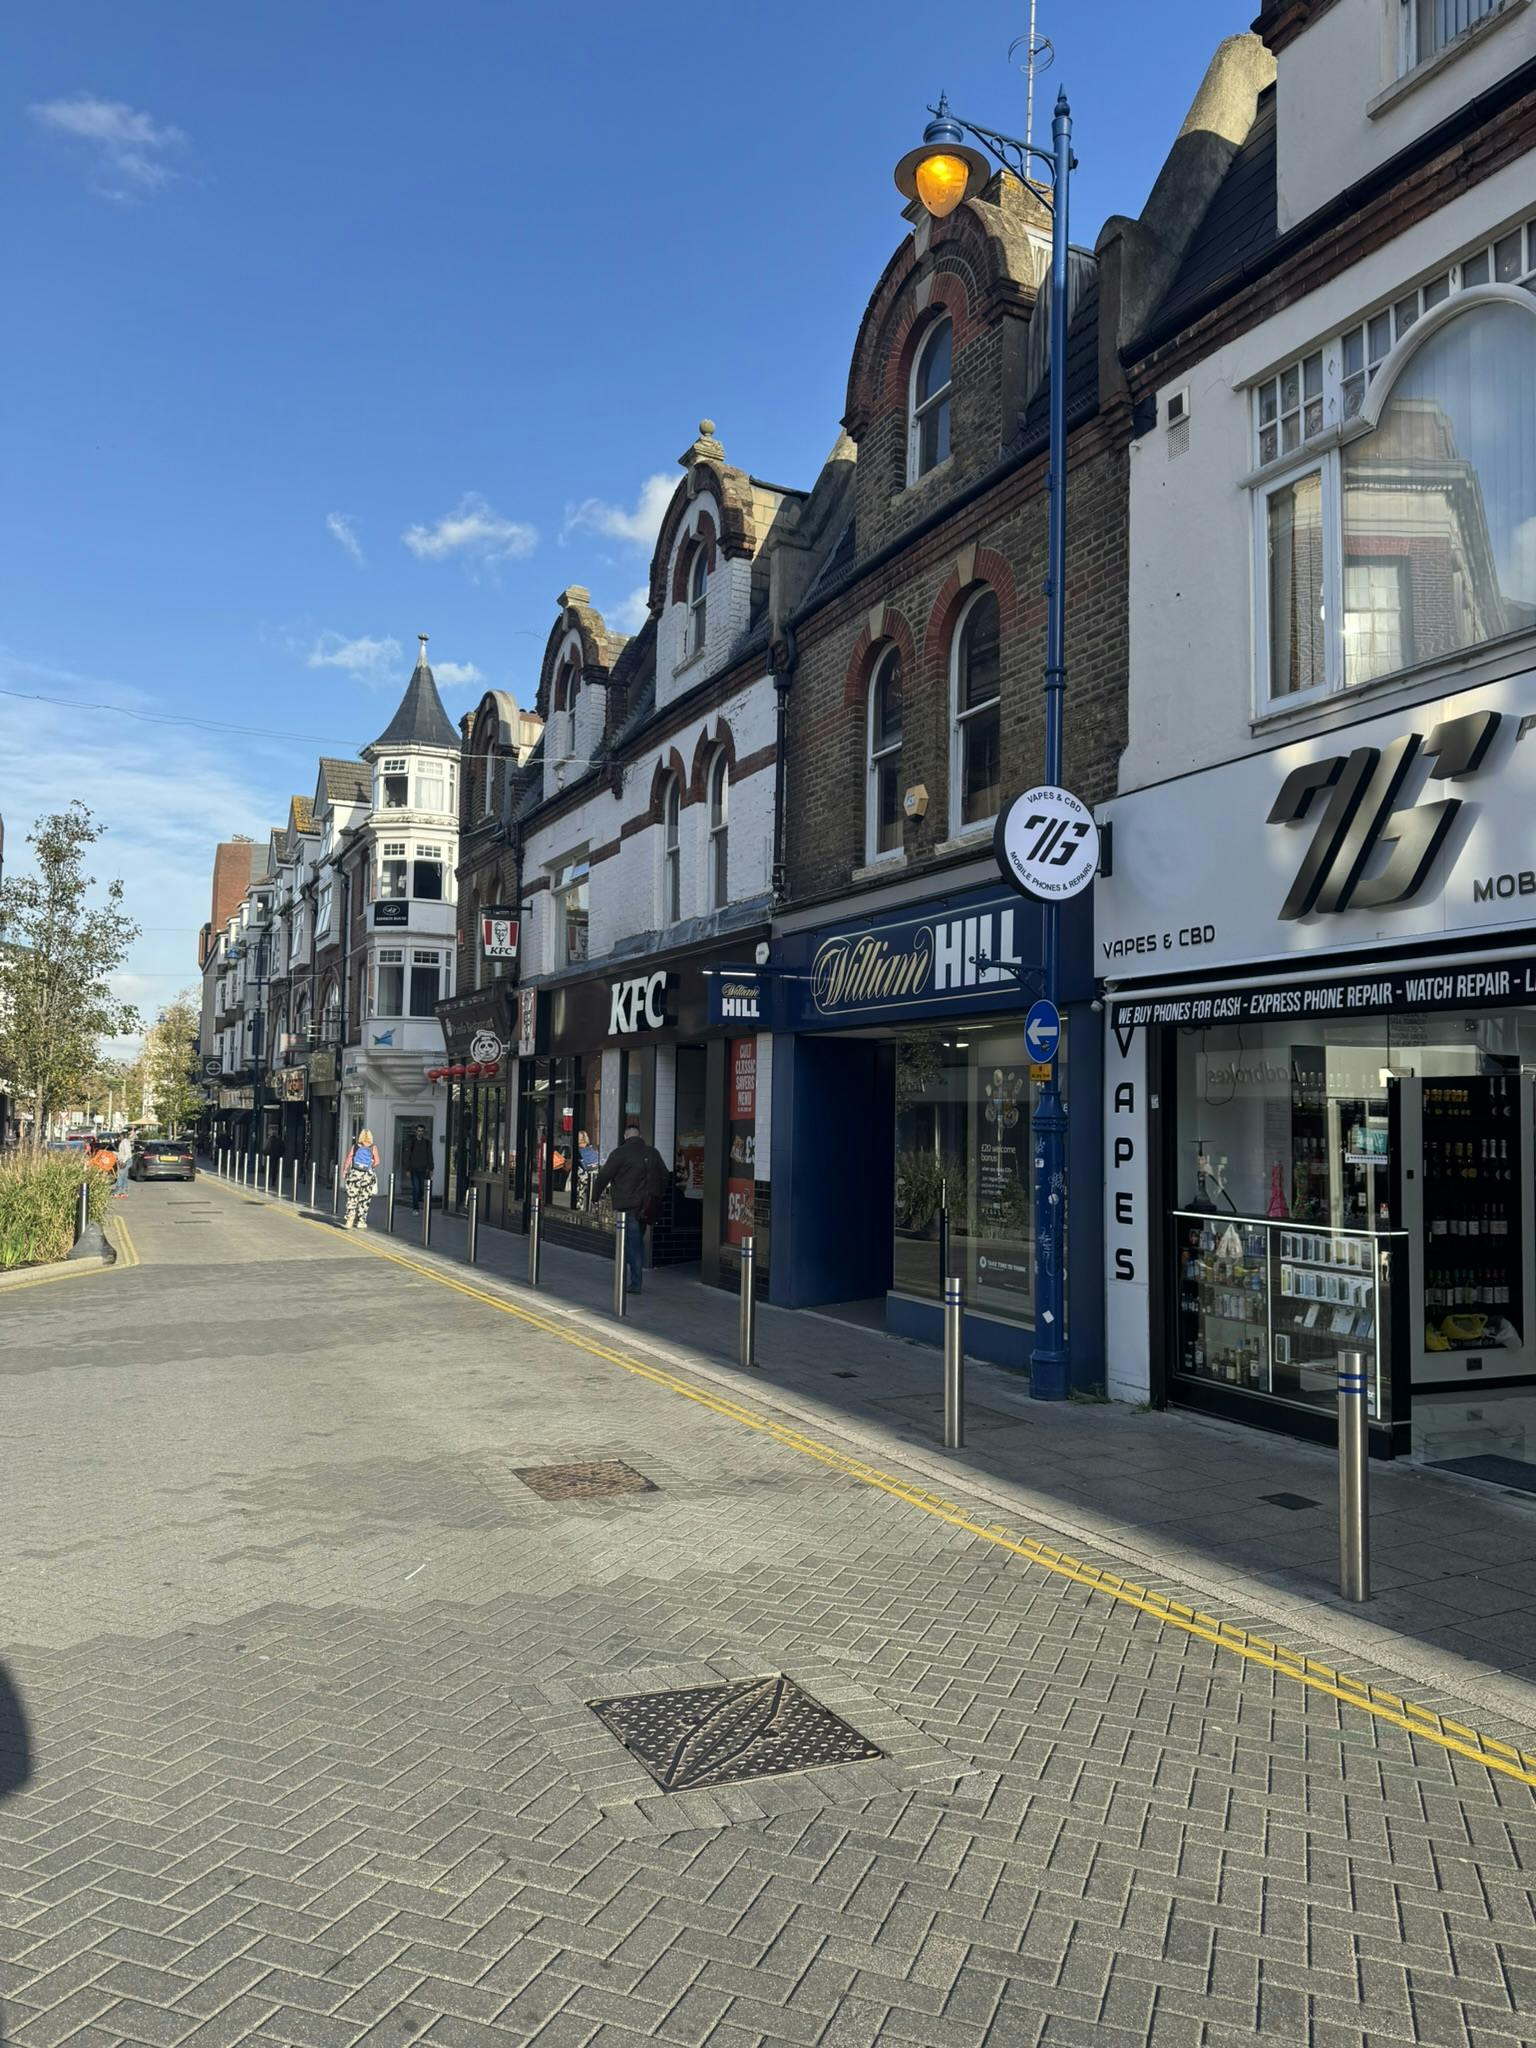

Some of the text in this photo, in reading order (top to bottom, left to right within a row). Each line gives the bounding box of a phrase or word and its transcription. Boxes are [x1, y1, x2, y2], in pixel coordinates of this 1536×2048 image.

[1027, 791, 1082, 813] VAPES & CBD
[1010, 851, 1093, 892] MOBILE PHONES & REPAIRS
[490, 946, 513, 955] KFC
[1103, 925, 1216, 959] VAPES & CBD
[810, 909, 1023, 1007] William HILL
[722, 983, 761, 998] William
[1118, 1007, 1133, 1025] WE
[1133, 1004, 1152, 1023] BUY
[1153, 1001, 1190, 1022] PHONES
[1192, 1000, 1212, 1019] FOR
[1213, 997, 1241, 1017] CASH
[1249, 991, 1301, 1014] EXPRESS
[1304, 987, 1344, 1010] PHONE
[1347, 982, 1393, 1007] REPAIR
[1405, 976, 1453, 1002] WATCH
[1456, 971, 1510, 997] REPAIR
[608, 971, 667, 1035] KFC
[722, 998, 760, 1017] HILL
[739, 1043, 752, 1059] CULT
[735, 1059, 756, 1075] CLASSIC
[735, 1074, 755, 1090] SAVERS
[737, 1091, 752, 1106] MENU
[1114, 1027, 1135, 1281] VAPES
